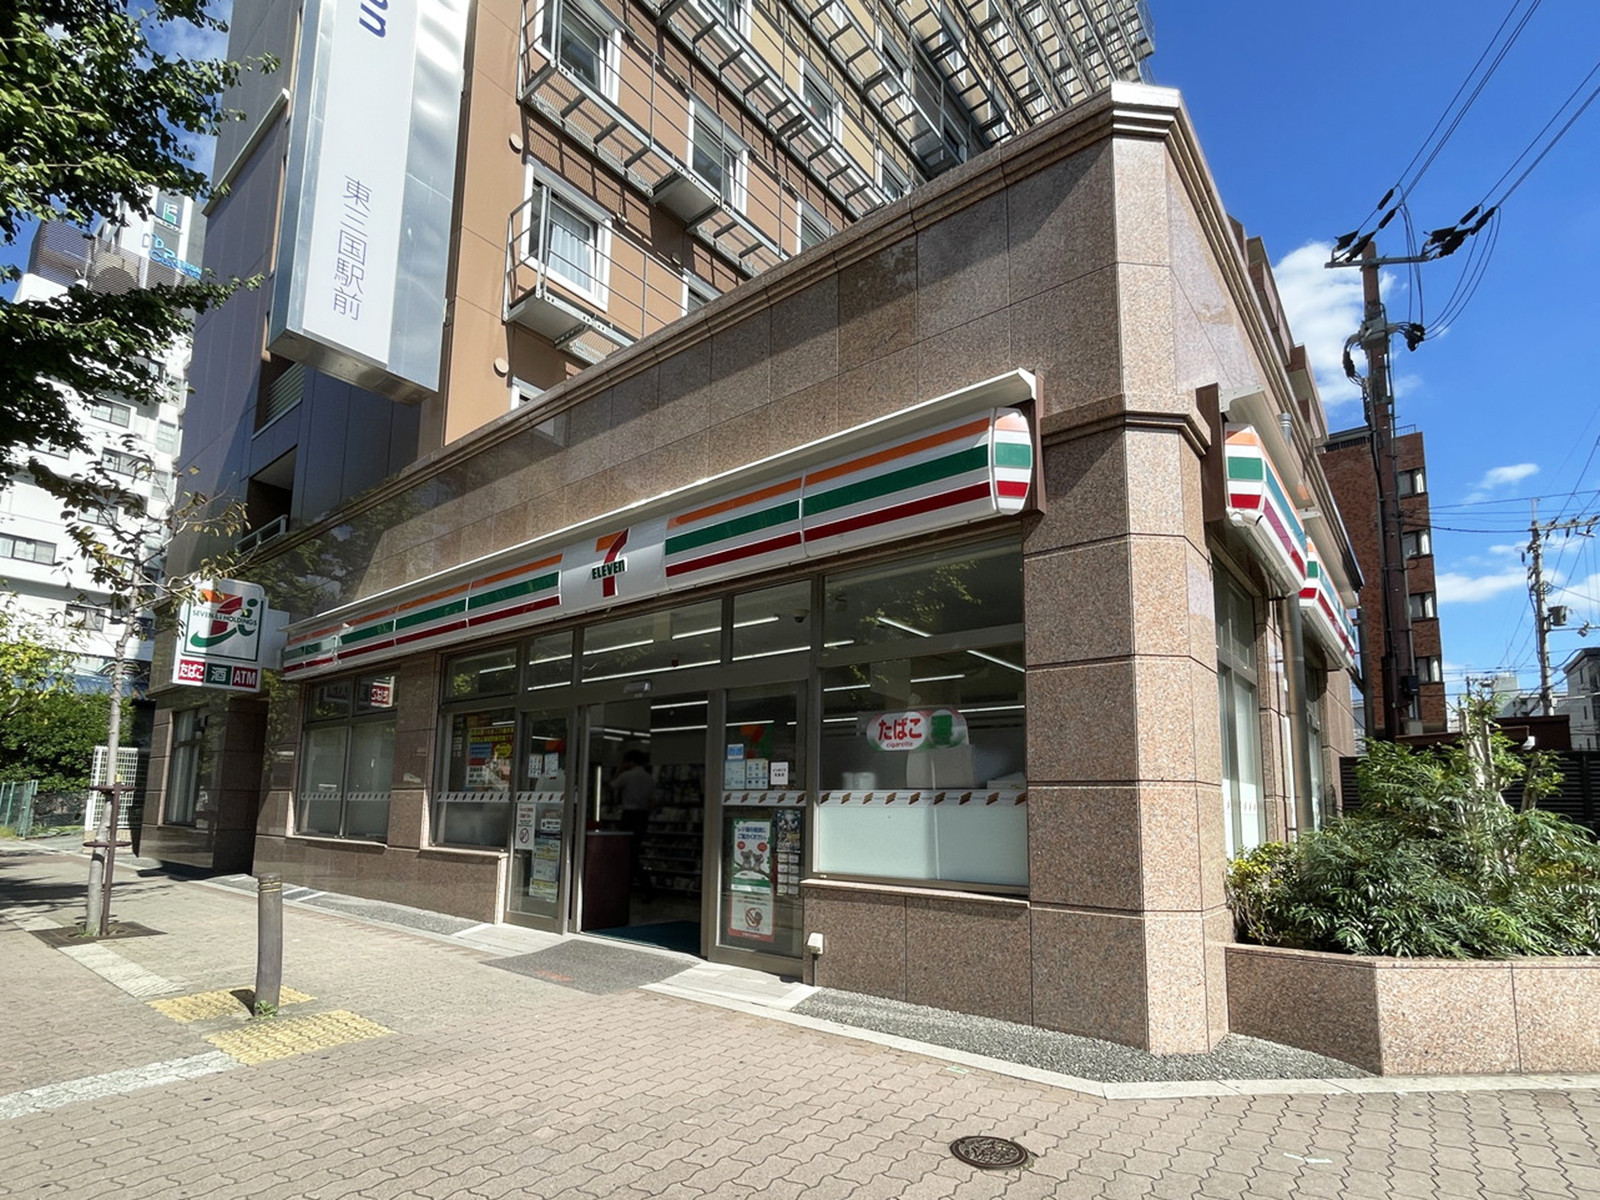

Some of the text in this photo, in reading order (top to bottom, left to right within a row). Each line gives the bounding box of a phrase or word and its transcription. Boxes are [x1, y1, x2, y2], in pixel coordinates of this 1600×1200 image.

[333, 174, 372, 321] 東三国駅前
[223, 614, 257, 626] HOLDINGS
[179, 663, 256, 685] たばこ 酒 ATM
[878, 717, 922, 741] たばこ
